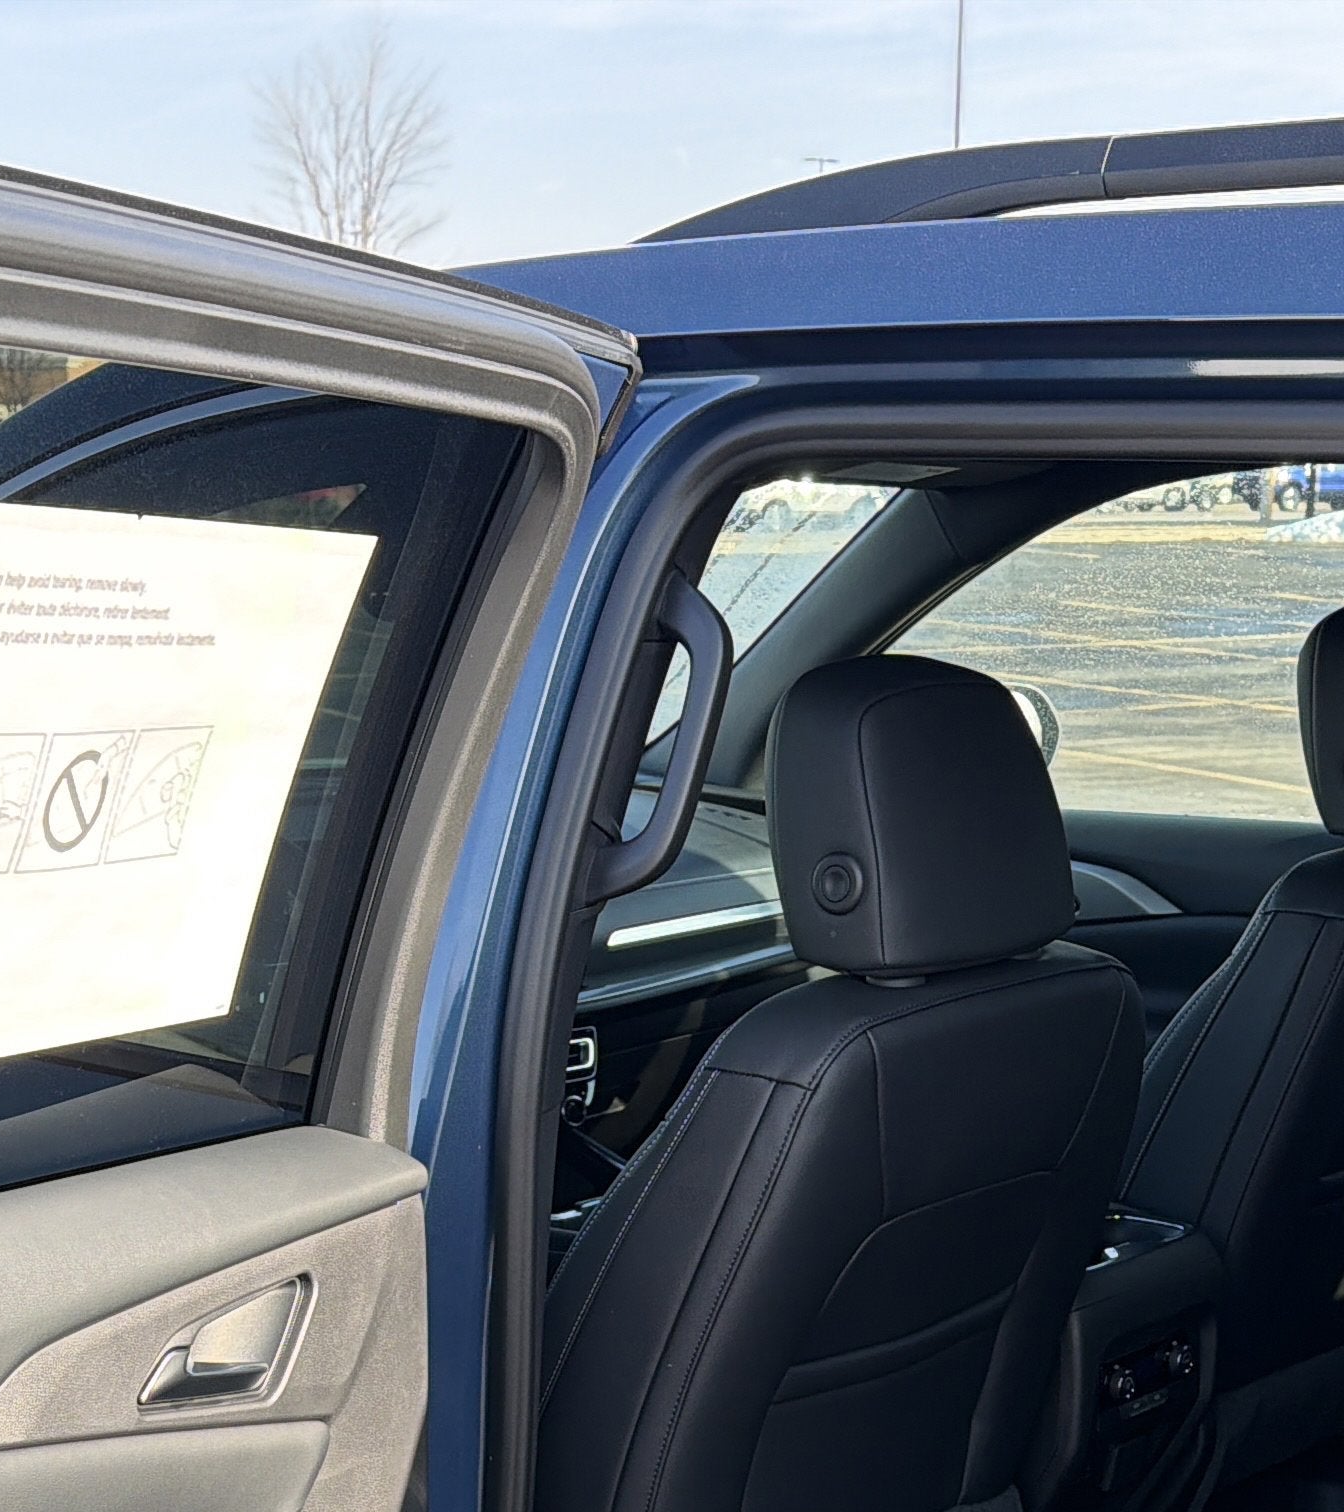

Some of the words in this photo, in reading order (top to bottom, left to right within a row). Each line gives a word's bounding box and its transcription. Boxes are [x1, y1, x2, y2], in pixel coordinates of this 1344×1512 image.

[4, 571, 25, 590] help
[27, 573, 51, 589] avoid
[86, 577, 118, 592] remove
[77, 633, 93, 648] que
[95, 634, 105, 646] se
